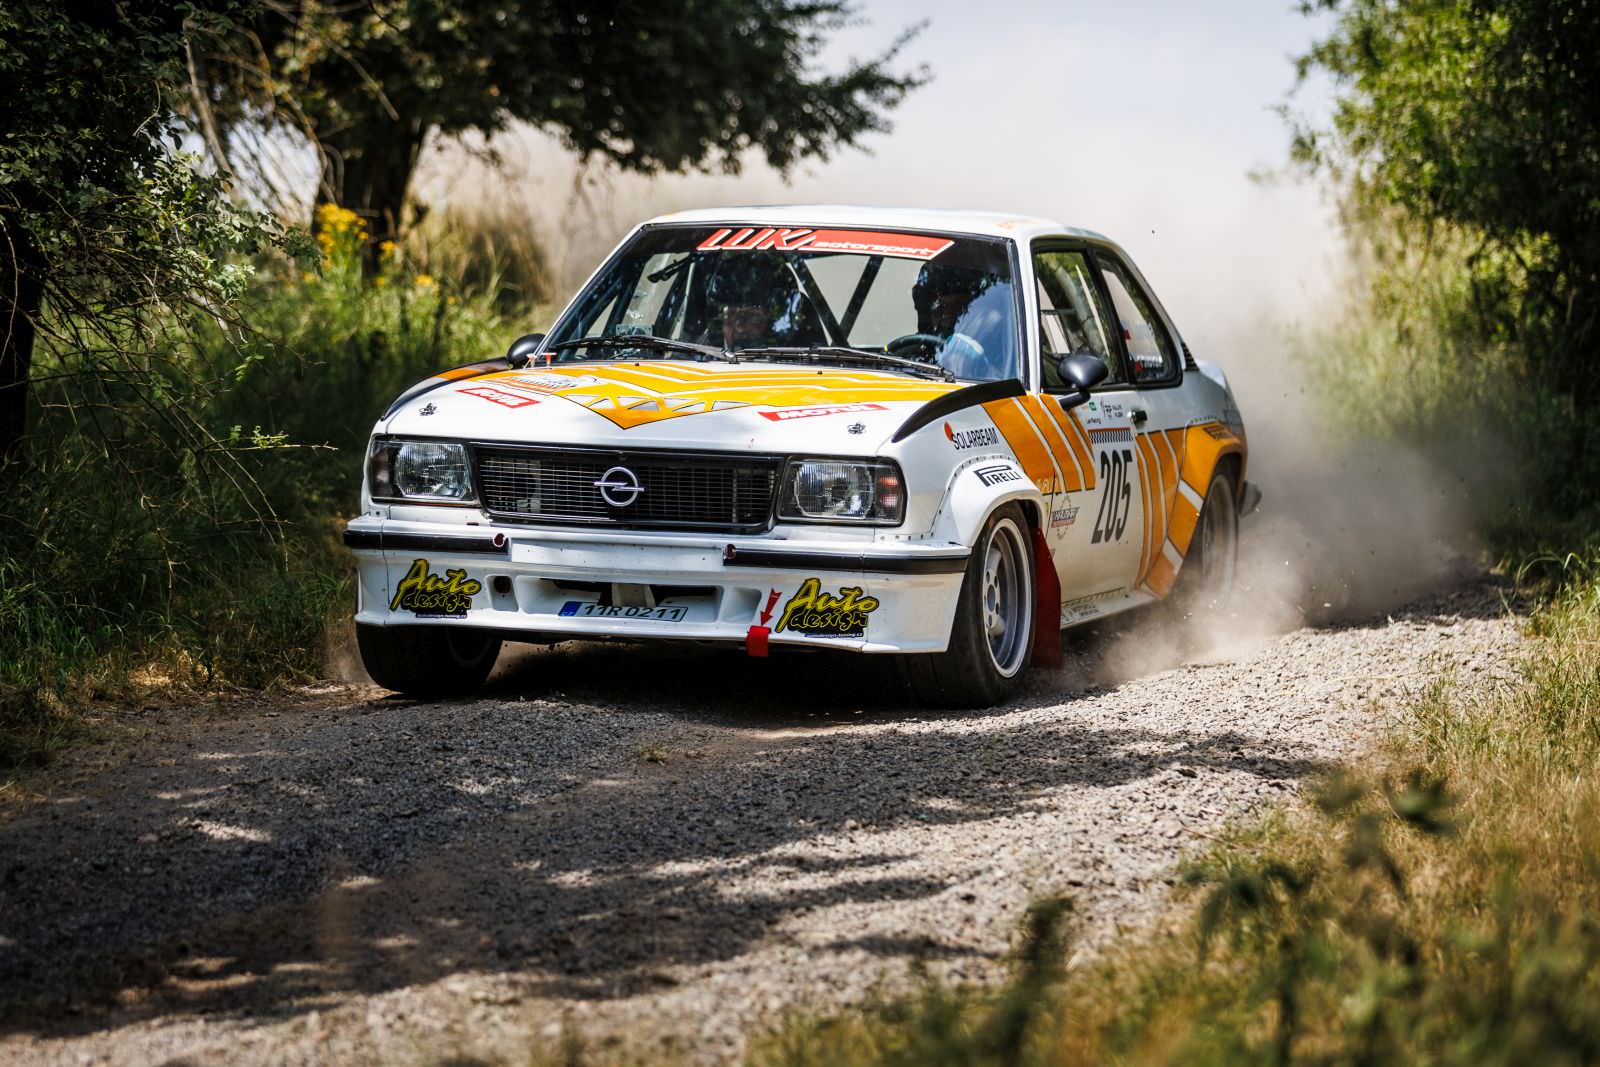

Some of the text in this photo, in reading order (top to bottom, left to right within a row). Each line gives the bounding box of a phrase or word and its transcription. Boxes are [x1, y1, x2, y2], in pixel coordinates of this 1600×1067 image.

[815, 241, 936, 255] motorsport
[776, 404, 876, 419] MOTUL
[951, 427, 999, 450] SOLARBEAM
[973, 465, 1022, 487] PIRELLI
[1091, 449, 1132, 544] 205
[390, 559, 482, 611] Auto
[402, 588, 473, 612] design
[776, 578, 879, 633] Auto
[584, 604, 623, 616] 11R
[625, 606, 681, 619] 0211
[790, 608, 869, 630] design
